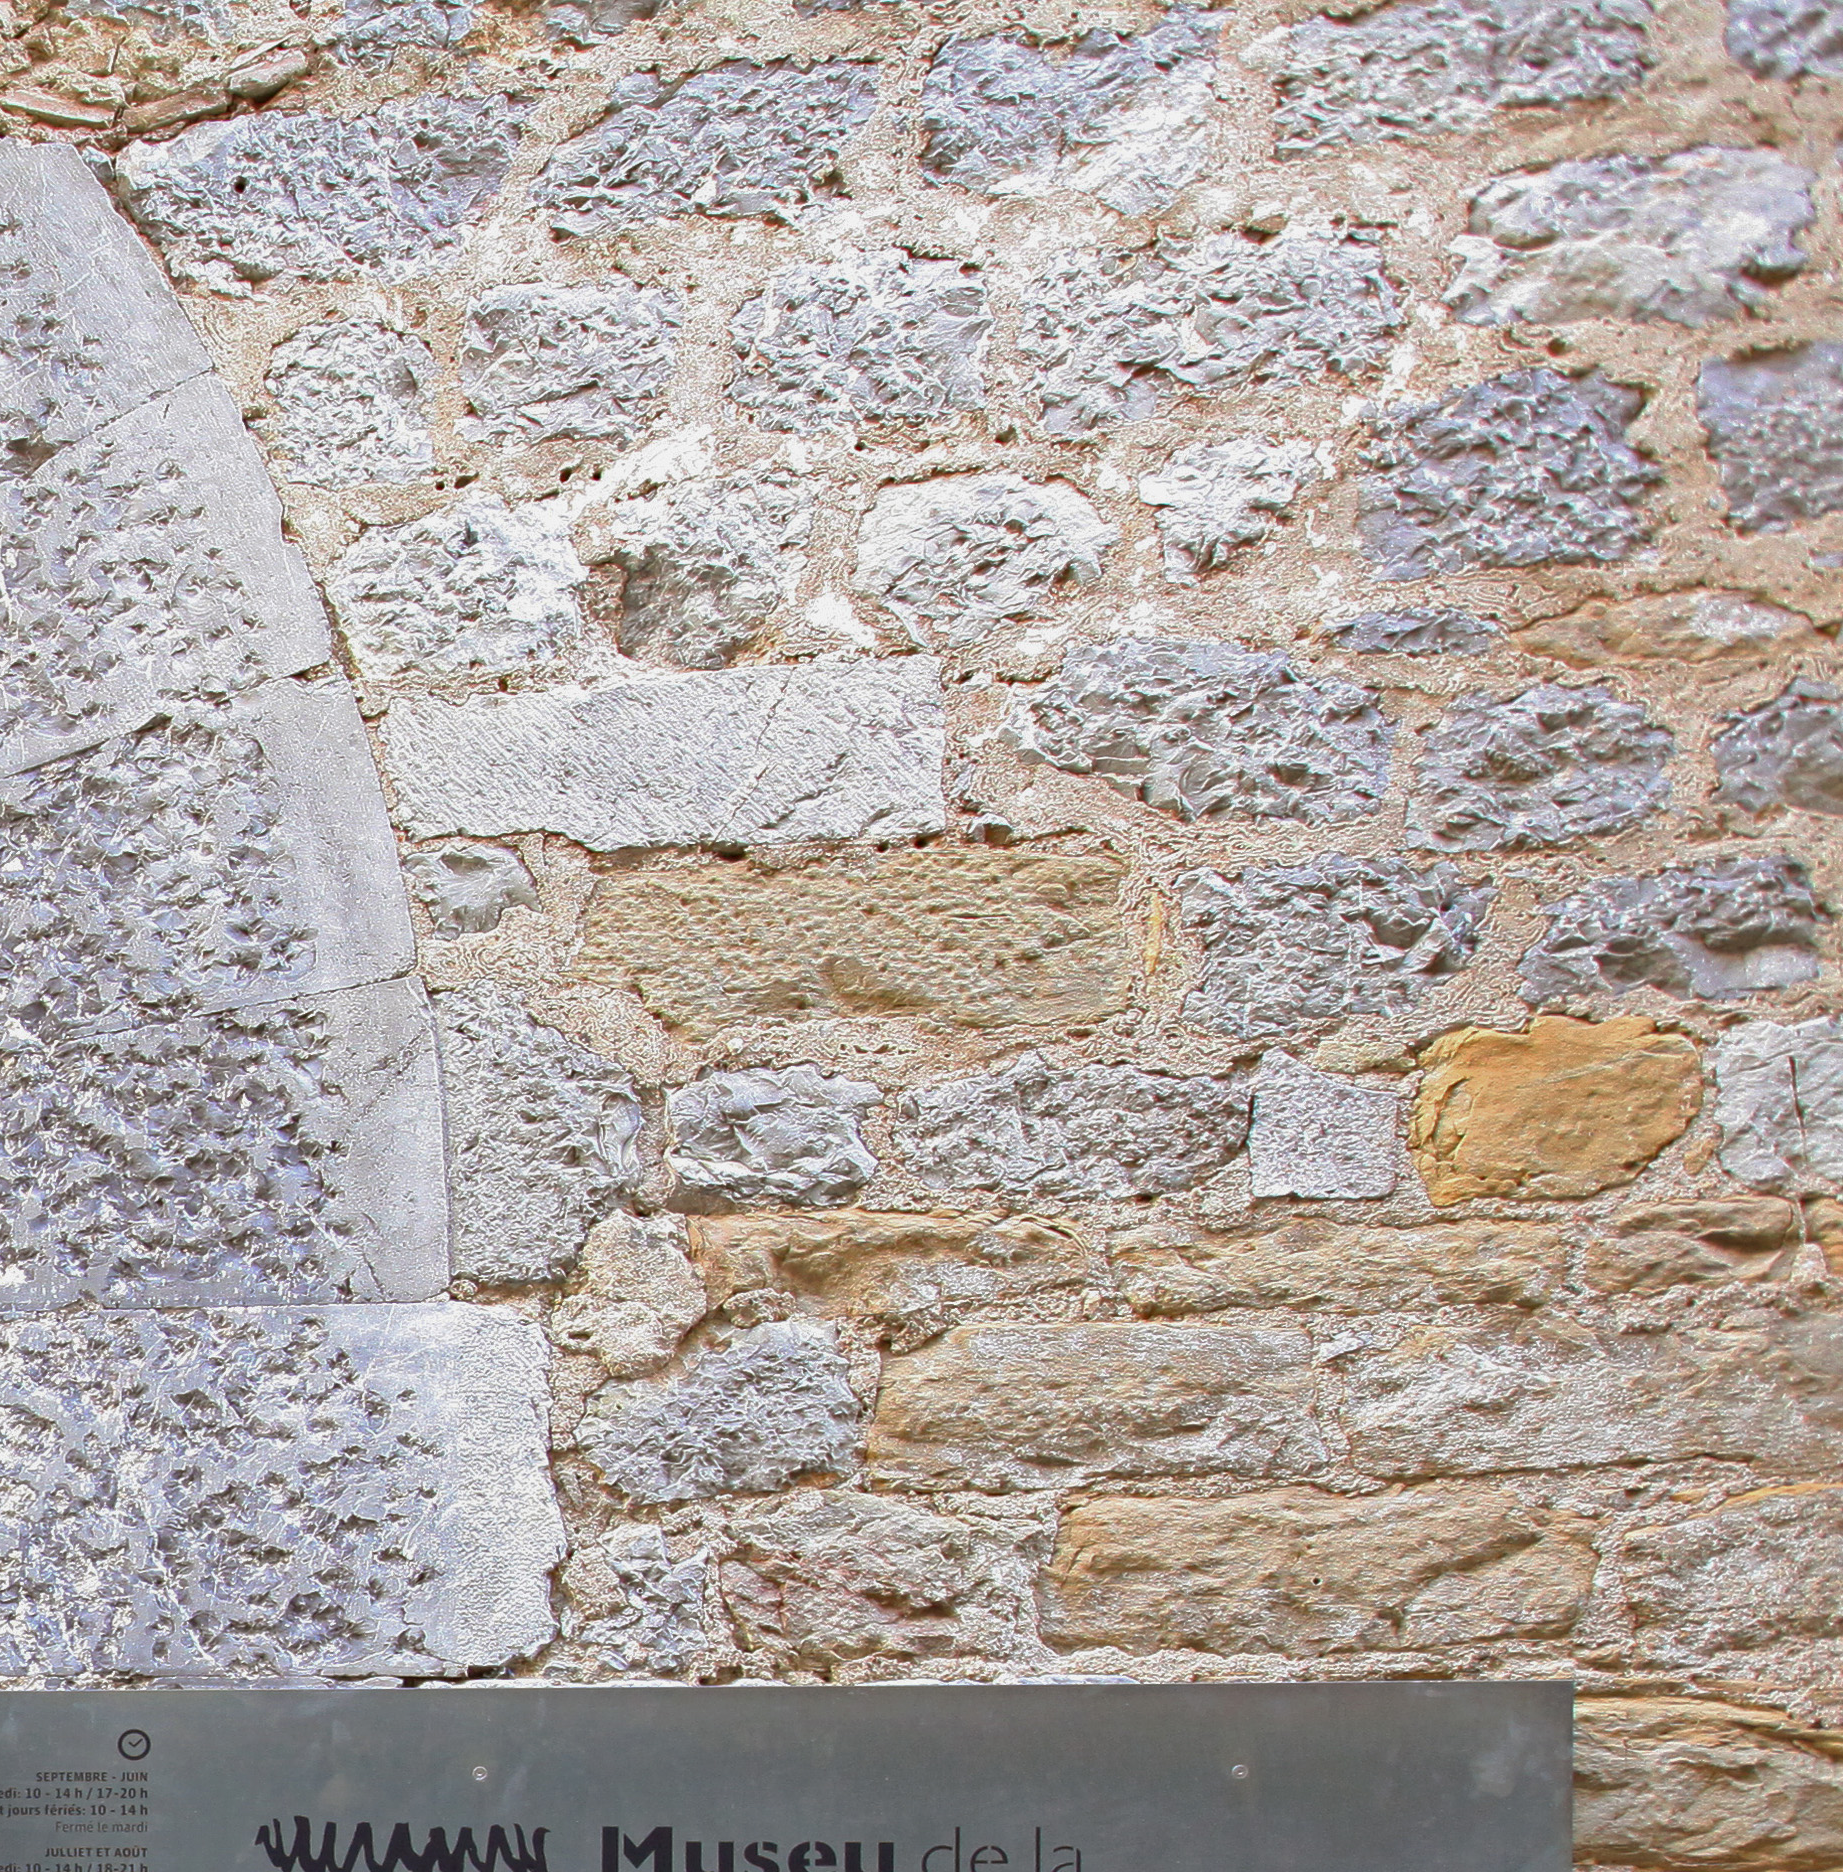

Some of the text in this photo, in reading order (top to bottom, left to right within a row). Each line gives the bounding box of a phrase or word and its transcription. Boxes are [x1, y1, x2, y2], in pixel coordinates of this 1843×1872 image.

[55, 1821, 148, 1832] Fermé le mardi
